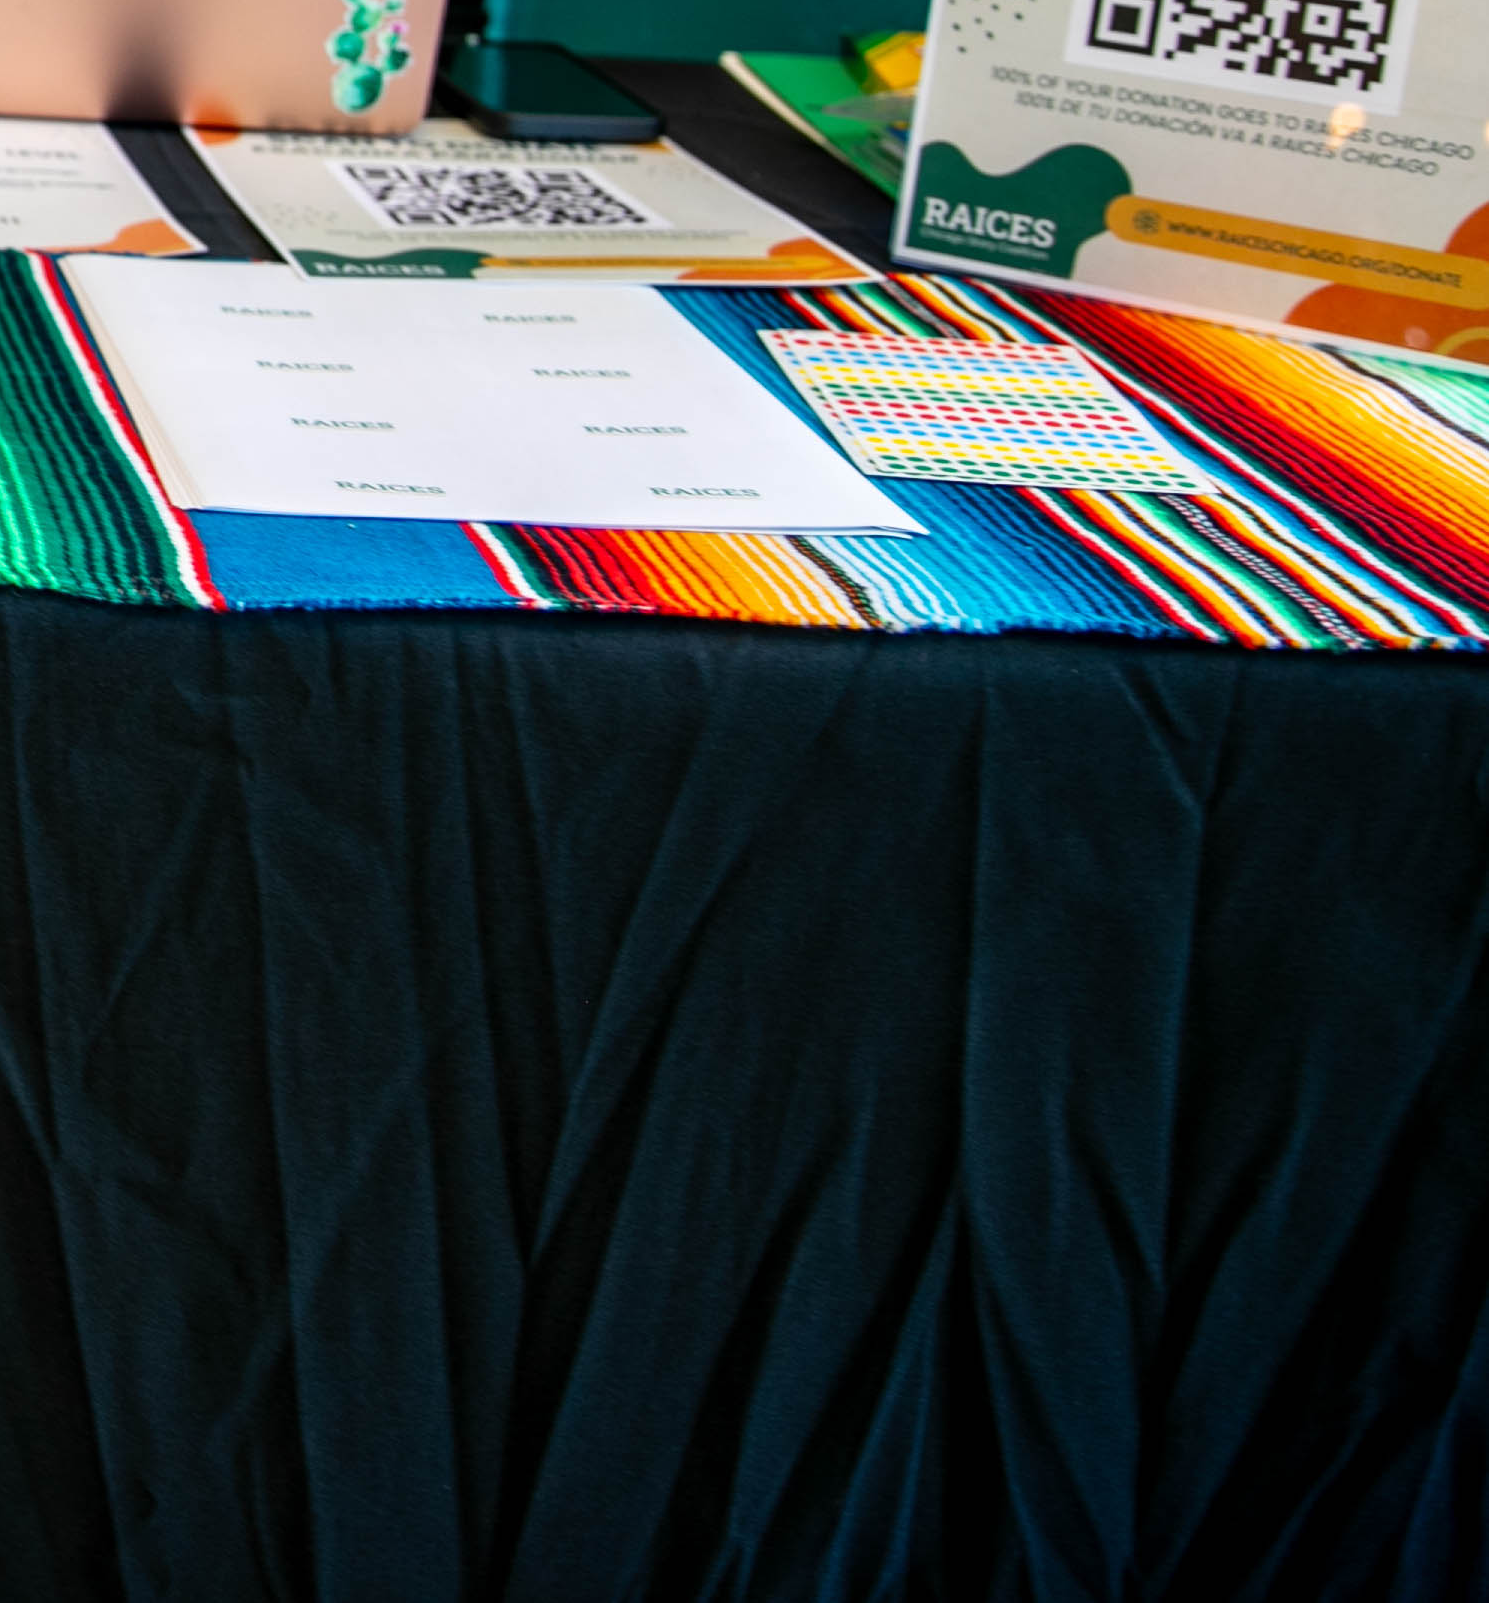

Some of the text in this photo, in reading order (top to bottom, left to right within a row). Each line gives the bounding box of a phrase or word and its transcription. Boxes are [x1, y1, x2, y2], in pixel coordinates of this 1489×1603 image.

[990, 65, 1476, 161] 100% OF YOUR DONATION GOES TO RAES CHICAGO
[1059, 99, 1082, 116] DE
[1087, 103, 1112, 120] TU
[1220, 124, 1246, 144] VA
[1251, 132, 1265, 146] A
[1269, 134, 1337, 161] RAICES
[1340, 147, 1440, 177] CHICAGO
[922, 196, 1057, 249] RAICES
[311, 261, 447, 277] RAICES
[482, 313, 577, 325] RAICES
[256, 360, 355, 372] RAICES
[532, 367, 631, 379] RAICES
[290, 416, 395, 430] RAICES
[583, 424, 688, 436] RAICES
[334, 480, 447, 495] RAICES
[647, 485, 761, 498] RAICES
